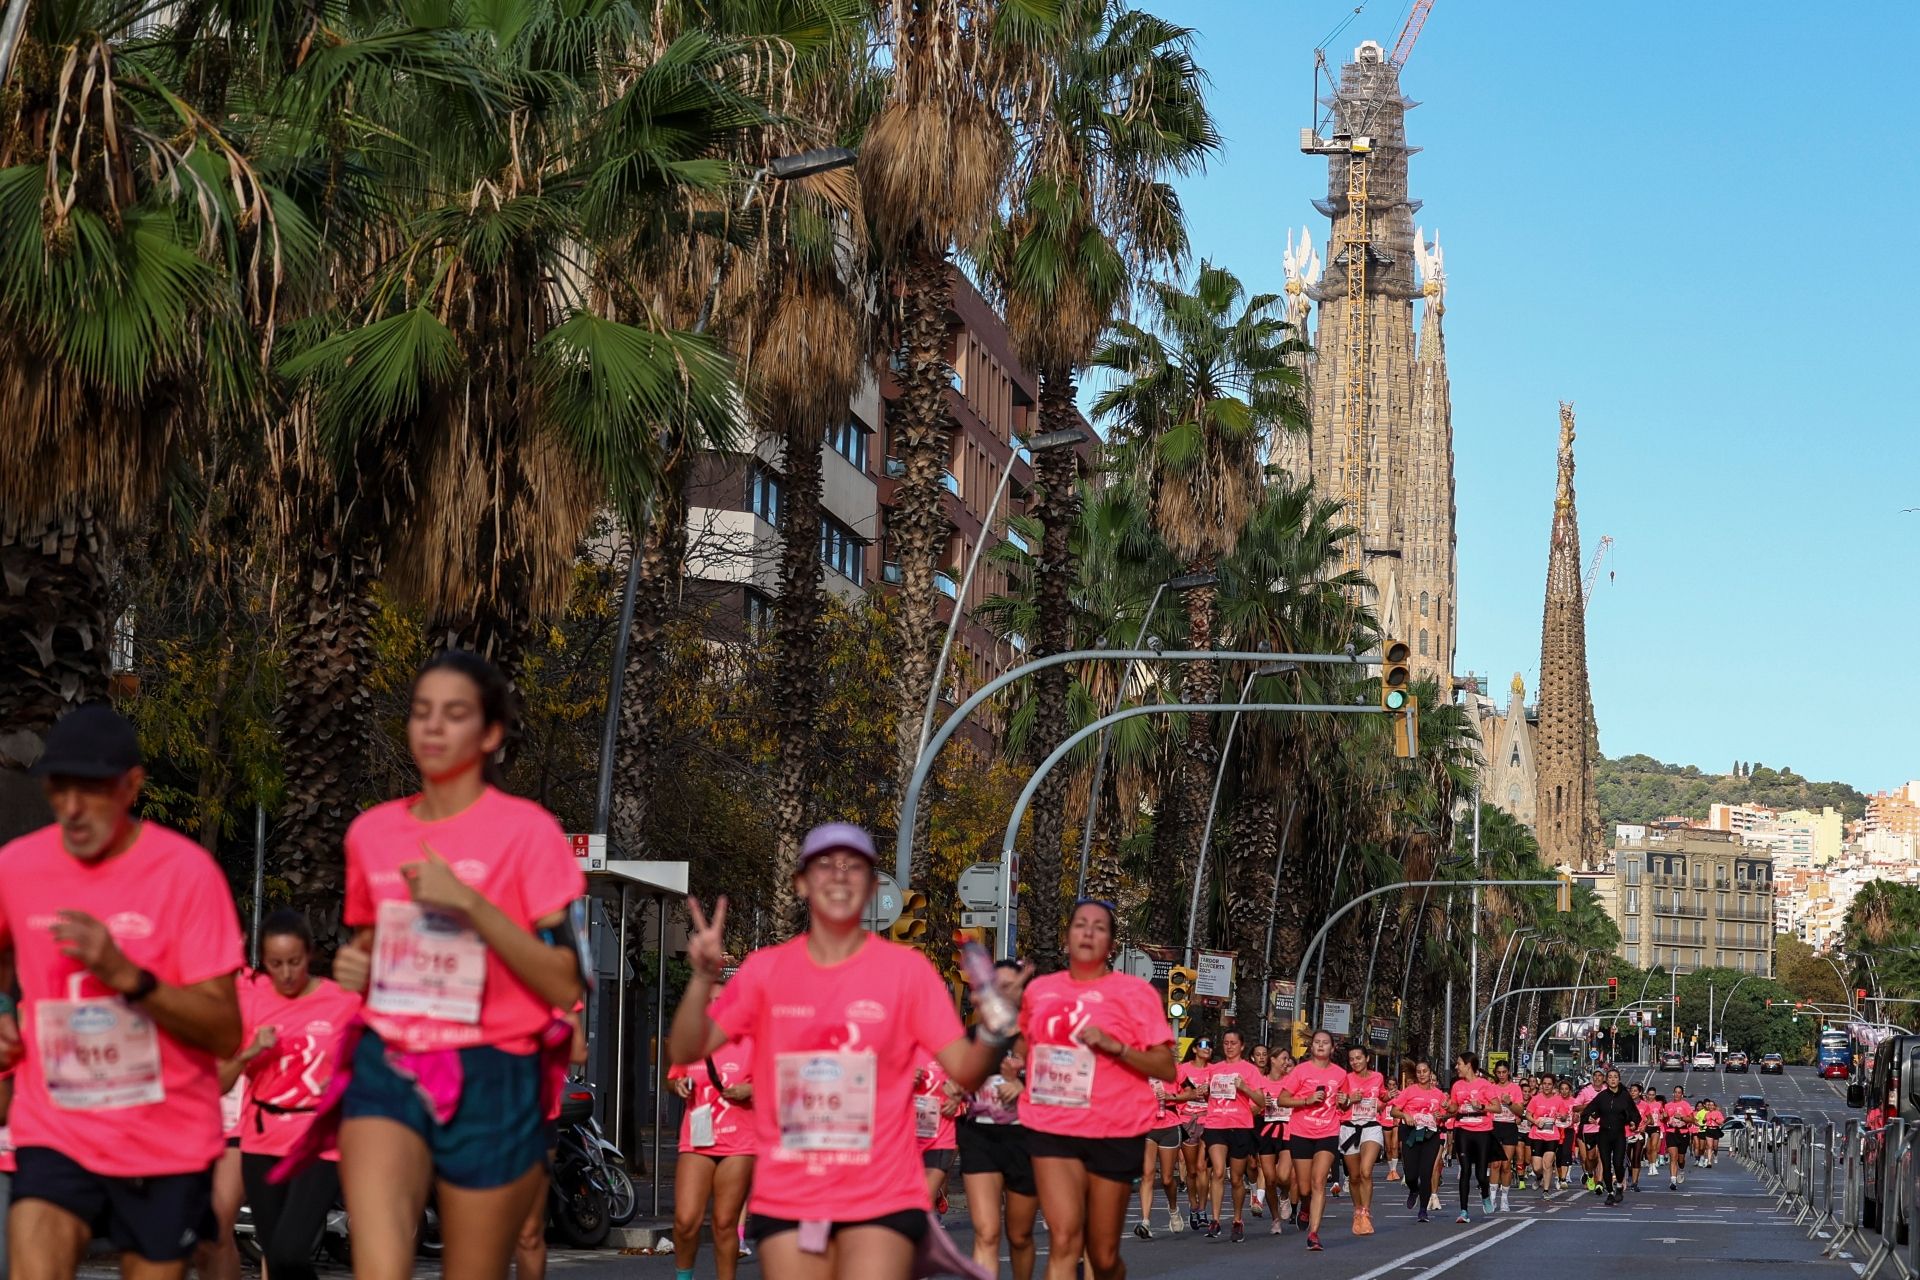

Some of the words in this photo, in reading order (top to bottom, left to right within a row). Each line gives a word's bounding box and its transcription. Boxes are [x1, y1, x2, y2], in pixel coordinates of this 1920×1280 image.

[578, 837, 584, 845] 6
[575, 848, 586, 856] 54
[1523, 1055, 1530, 1063] P
[916, 1111, 926, 1120] 16
